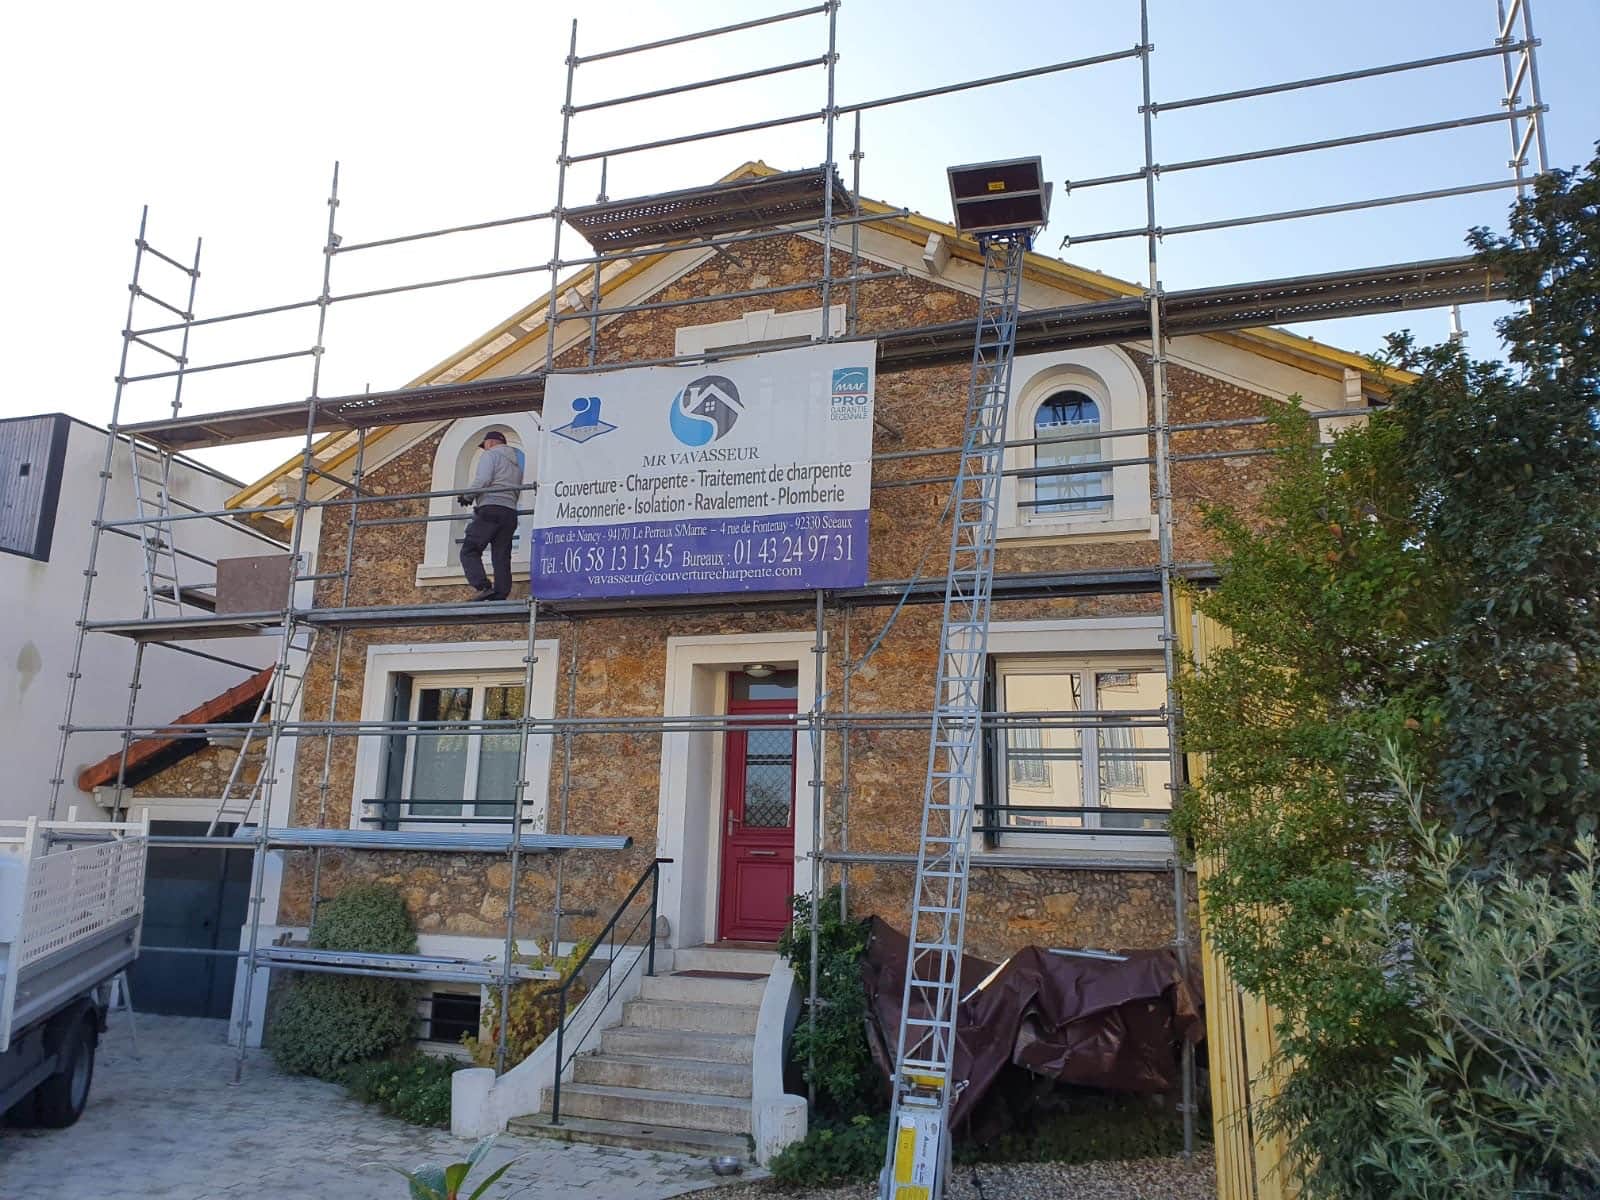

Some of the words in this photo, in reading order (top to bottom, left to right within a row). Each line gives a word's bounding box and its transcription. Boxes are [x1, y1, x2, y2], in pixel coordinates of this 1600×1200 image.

[831, 395, 868, 406] PRO
[831, 405, 868, 414] GARANTIE
[641, 454, 667, 468] MR
[670, 446, 761, 465] VAVASSEUR
[554, 480, 617, 498] Couverture
[626, 472, 689, 495] Charpente
[697, 468, 767, 487] Traitement
[768, 463, 784, 483] de
[786, 462, 852, 485] charpente
[556, 499, 626, 523] Maçonnerie
[634, 494, 685, 515] Isolation
[694, 491, 769, 511] Ravalement
[778, 484, 845, 505] Plomberie
[544, 531, 554, 545] 20
[554, 533, 566, 544] rue
[566, 530, 576, 543] de
[576, 529, 601, 545] Nancy
[607, 526, 631, 542] 94170
[632, 526, 643, 540] Le
[644, 525, 673, 539] Perreux
[674, 522, 707, 537] S/Marne
[719, 522, 726, 537] 4
[727, 522, 739, 534] rue
[740, 519, 751, 534] de
[752, 518, 788, 536] Fontenay
[795, 515, 821, 530] 92330
[821, 515, 853, 529] Sceaux
[564, 547, 582, 574] 06
[584, 546, 605, 572] 58
[608, 545, 627, 571] 13
[633, 544, 650, 570] 13
[654, 543, 673, 569] 45
[682, 550, 724, 567] Bureaux
[734, 539, 752, 565] 01
[758, 537, 777, 564] 43
[782, 535, 804, 563] 24
[808, 534, 829, 562] 97
[833, 534, 854, 561] 31
[588, 566, 802, 586] vavasseur@couverturecharpente.com
